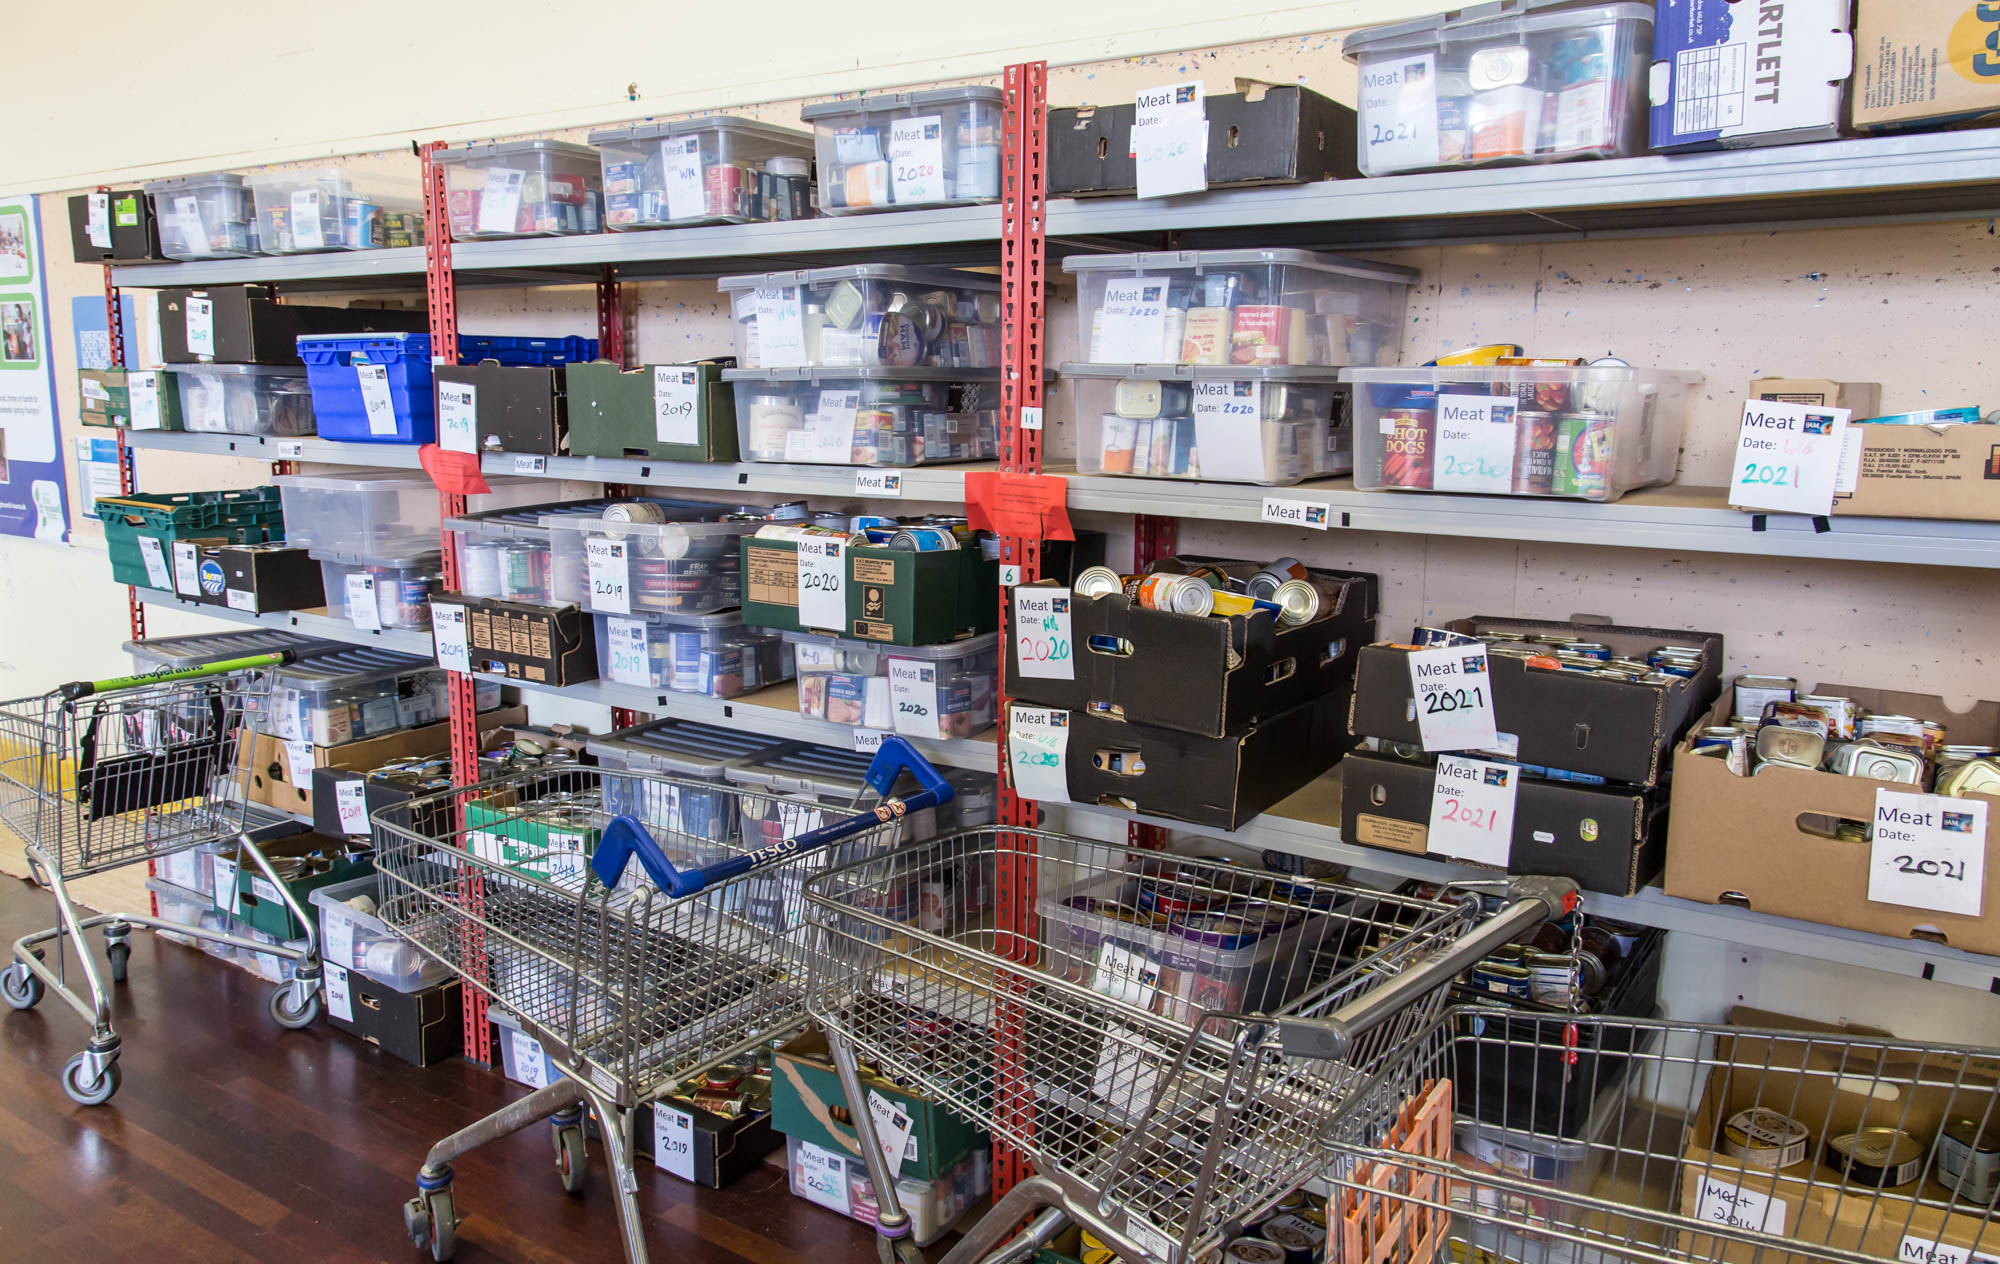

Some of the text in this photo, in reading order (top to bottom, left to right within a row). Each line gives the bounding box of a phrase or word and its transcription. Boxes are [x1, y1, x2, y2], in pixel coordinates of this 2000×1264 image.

[1754, 0, 1784, 104] RTLETT
[1364, 71, 1399, 89] Meat
[1137, 92, 1171, 110] Meat
[1366, 98, 1390, 110] Date:
[1138, 116, 1162, 127] Date:
[894, 128, 921, 142] Meat
[1370, 124, 1417, 146] 2021
[664, 143, 686, 157] Meat
[895, 150, 914, 158] Date:
[488, 172, 508, 187] Meat
[896, 164, 934, 182] 2020
[756, 289, 780, 300] Meat
[1107, 289, 1138, 302] Meat
[758, 306, 774, 315] Date:
[1106, 305, 1160, 317] Date: 2020
[899, 324, 907, 351] HAM
[360, 370, 374, 380] Meat
[657, 372, 679, 383] Meat
[658, 390, 672, 398] Date:
[1196, 383, 1228, 396] Meat
[440, 391, 461, 403] Meat
[822, 397, 842, 408] Meat
[370, 400, 386, 413] 2019
[660, 402, 693, 418] 2019
[1197, 402, 1254, 415] Date: 2020
[1443, 406, 1485, 422] Meat
[1744, 411, 1796, 431] Meat
[446, 417, 469, 433] 2019
[1393, 427, 1428, 441] HOT
[1442, 429, 1470, 440] Date:
[1386, 440, 1425, 454] DOGS
[1742, 437, 1777, 450] Date:
[515, 459, 533, 469] Meat
[1443, 455, 1509, 478] 2020
[857, 477, 882, 488] Meat
[1741, 463, 1799, 489] 2021
[1267, 504, 1302, 520] Meat
[588, 544, 609, 556] Meat
[800, 542, 822, 554] Meat
[590, 560, 604, 568] Date:
[800, 559, 816, 568] Date:
[802, 572, 839, 592] 2020
[1005, 568, 1013, 583] 6
[595, 580, 623, 597] 2019
[1019, 599, 1048, 612] Meat
[435, 611, 453, 621] Meat
[1020, 616, 1040, 626] Date:
[608, 626, 629, 638] Meat
[440, 642, 464, 658] 2019
[1021, 636, 1070, 661] 2020
[614, 652, 640, 673] 2019
[892, 667, 917, 680] Meat
[1416, 662, 1458, 679] Meat
[894, 684, 911, 694] Date:
[1420, 681, 1448, 692] Date:
[1424, 686, 1484, 715] 2021
[899, 702, 928, 716] 2020
[1015, 711, 1046, 725] Meat
[855, 735, 879, 746] Meat
[1014, 731, 1036, 741] Date:
[1437, 761, 1479, 782] Meat
[338, 787, 354, 798] Meat
[1437, 784, 1465, 798] Date:
[341, 807, 362, 820] 2019
[1441, 799, 1497, 832] 2021
[1877, 806, 1933, 827] Meat
[1878, 827, 1915, 842] Date:
[548, 838, 566, 849] Meat
[744, 838, 798, 864] TESCO
[553, 862, 576, 880] 2019
[1893, 854, 1965, 881] 2021
[1104, 955, 1135, 978] Meat
[1101, 971, 1122, 986] Date:
[520, 1062, 540, 1078] 2019
[868, 1095, 891, 1119] Meat
[655, 1107, 675, 1124] Meat
[662, 1136, 688, 1154] 2019
[803, 1150, 826, 1165] Meat
[807, 1176, 842, 1200] 2020
[1706, 1185, 1755, 1209] Meat
[1904, 1242, 1959, 1264] Meat
